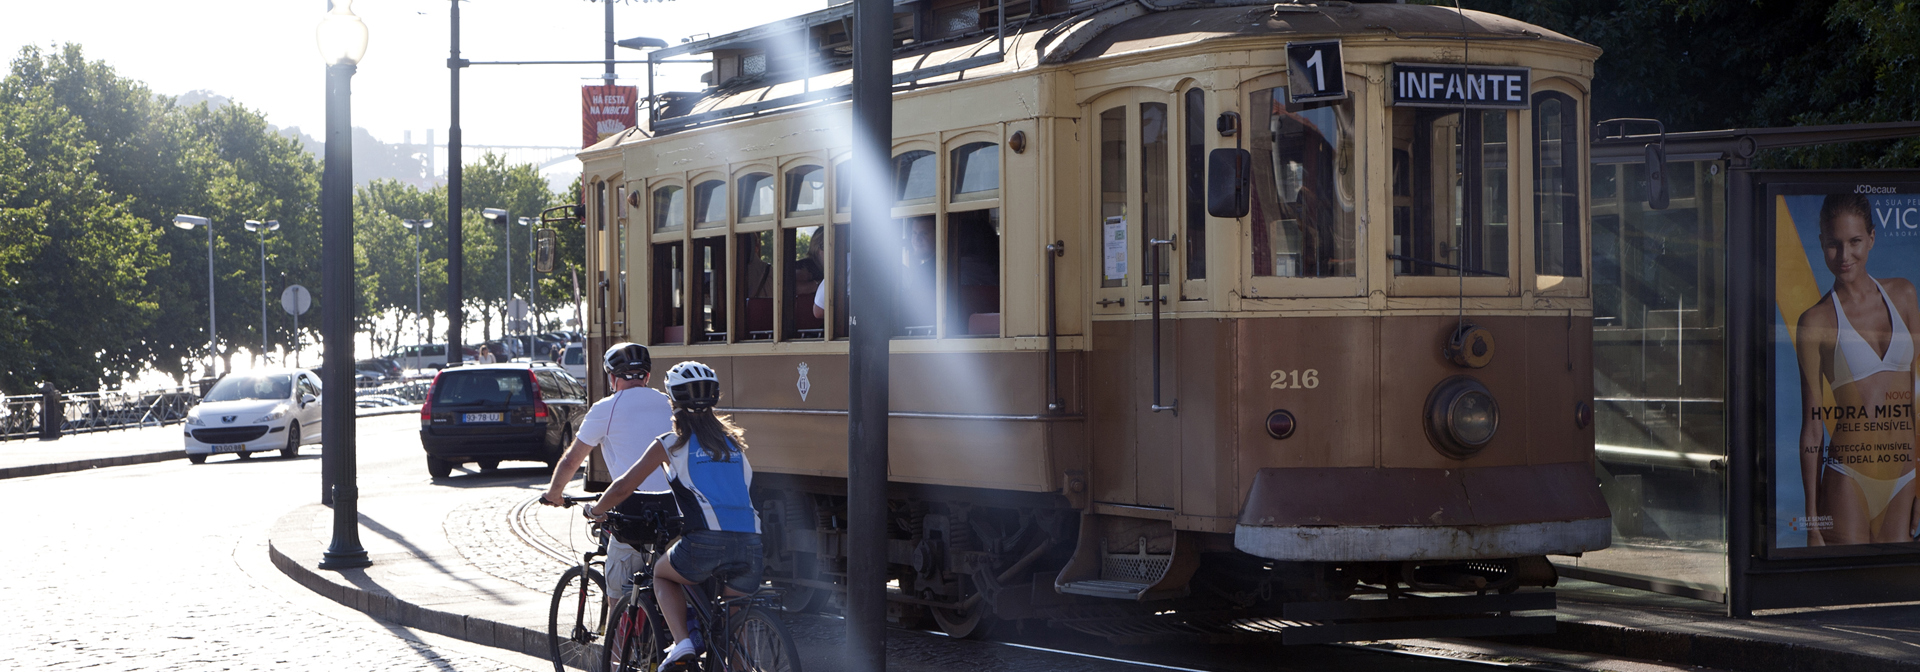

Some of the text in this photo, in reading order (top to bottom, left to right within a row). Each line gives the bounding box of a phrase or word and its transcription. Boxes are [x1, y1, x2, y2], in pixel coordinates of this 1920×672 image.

[1306, 50, 1325, 91] 1
[1399, 71, 1522, 101] INFANTE
[593, 94, 625, 104] HÁ FESTA
[590, 106, 601, 115] NA
[1853, 184, 1897, 194] JCDecaux
[1875, 207, 1918, 229] VIC
[1270, 368, 1319, 389] 216
[1885, 391, 1912, 400] NOVO
[1811, 405, 1868, 420] HYDRA
[1875, 404, 1912, 419] MIST
[1836, 419, 1912, 432] PELE SENSÍVEL
[1825, 442, 1872, 453] PROTECÇÃO
[1874, 441, 1912, 451] INVISÍVEL
[1822, 456, 1844, 465] PELE
[1846, 455, 1874, 464] IDEAL
[1876, 454, 1891, 463] AO
[1893, 453, 1912, 462] SOL
